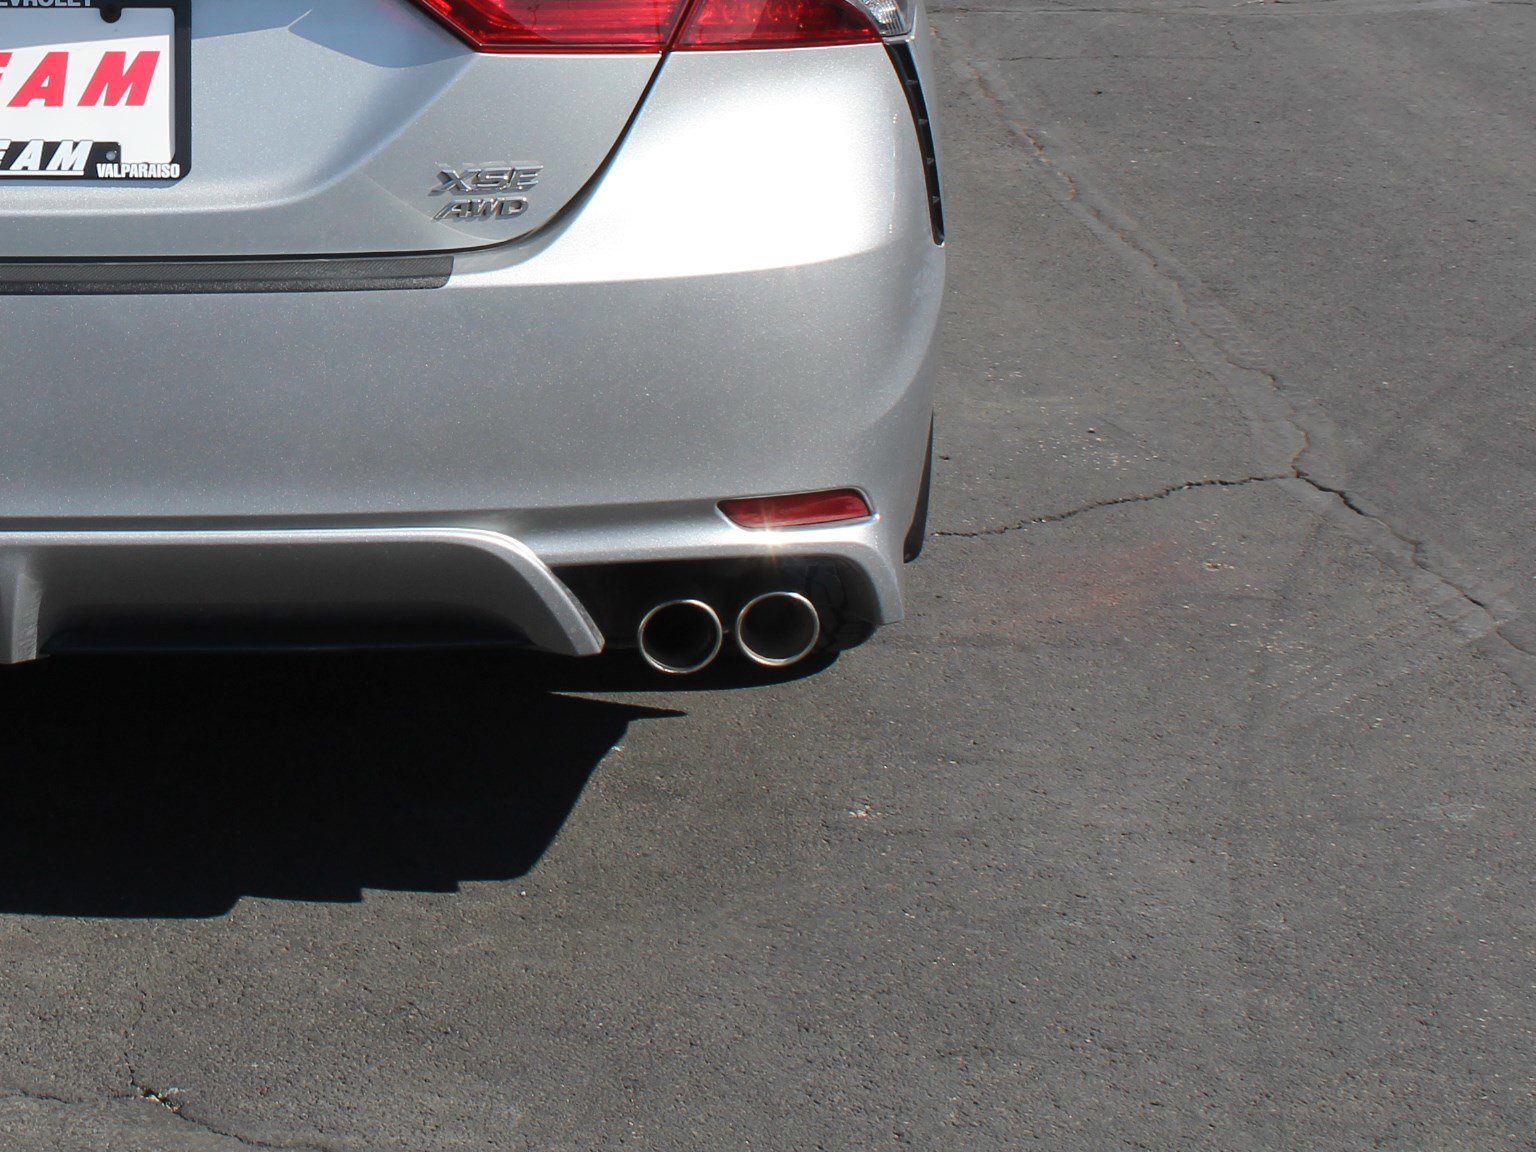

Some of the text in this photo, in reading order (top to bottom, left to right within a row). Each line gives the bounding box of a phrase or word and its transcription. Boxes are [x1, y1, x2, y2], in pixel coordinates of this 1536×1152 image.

[96, 163, 180, 178] VALPARAISO
[428, 164, 543, 196] XSE
[433, 197, 529, 220] AWD
